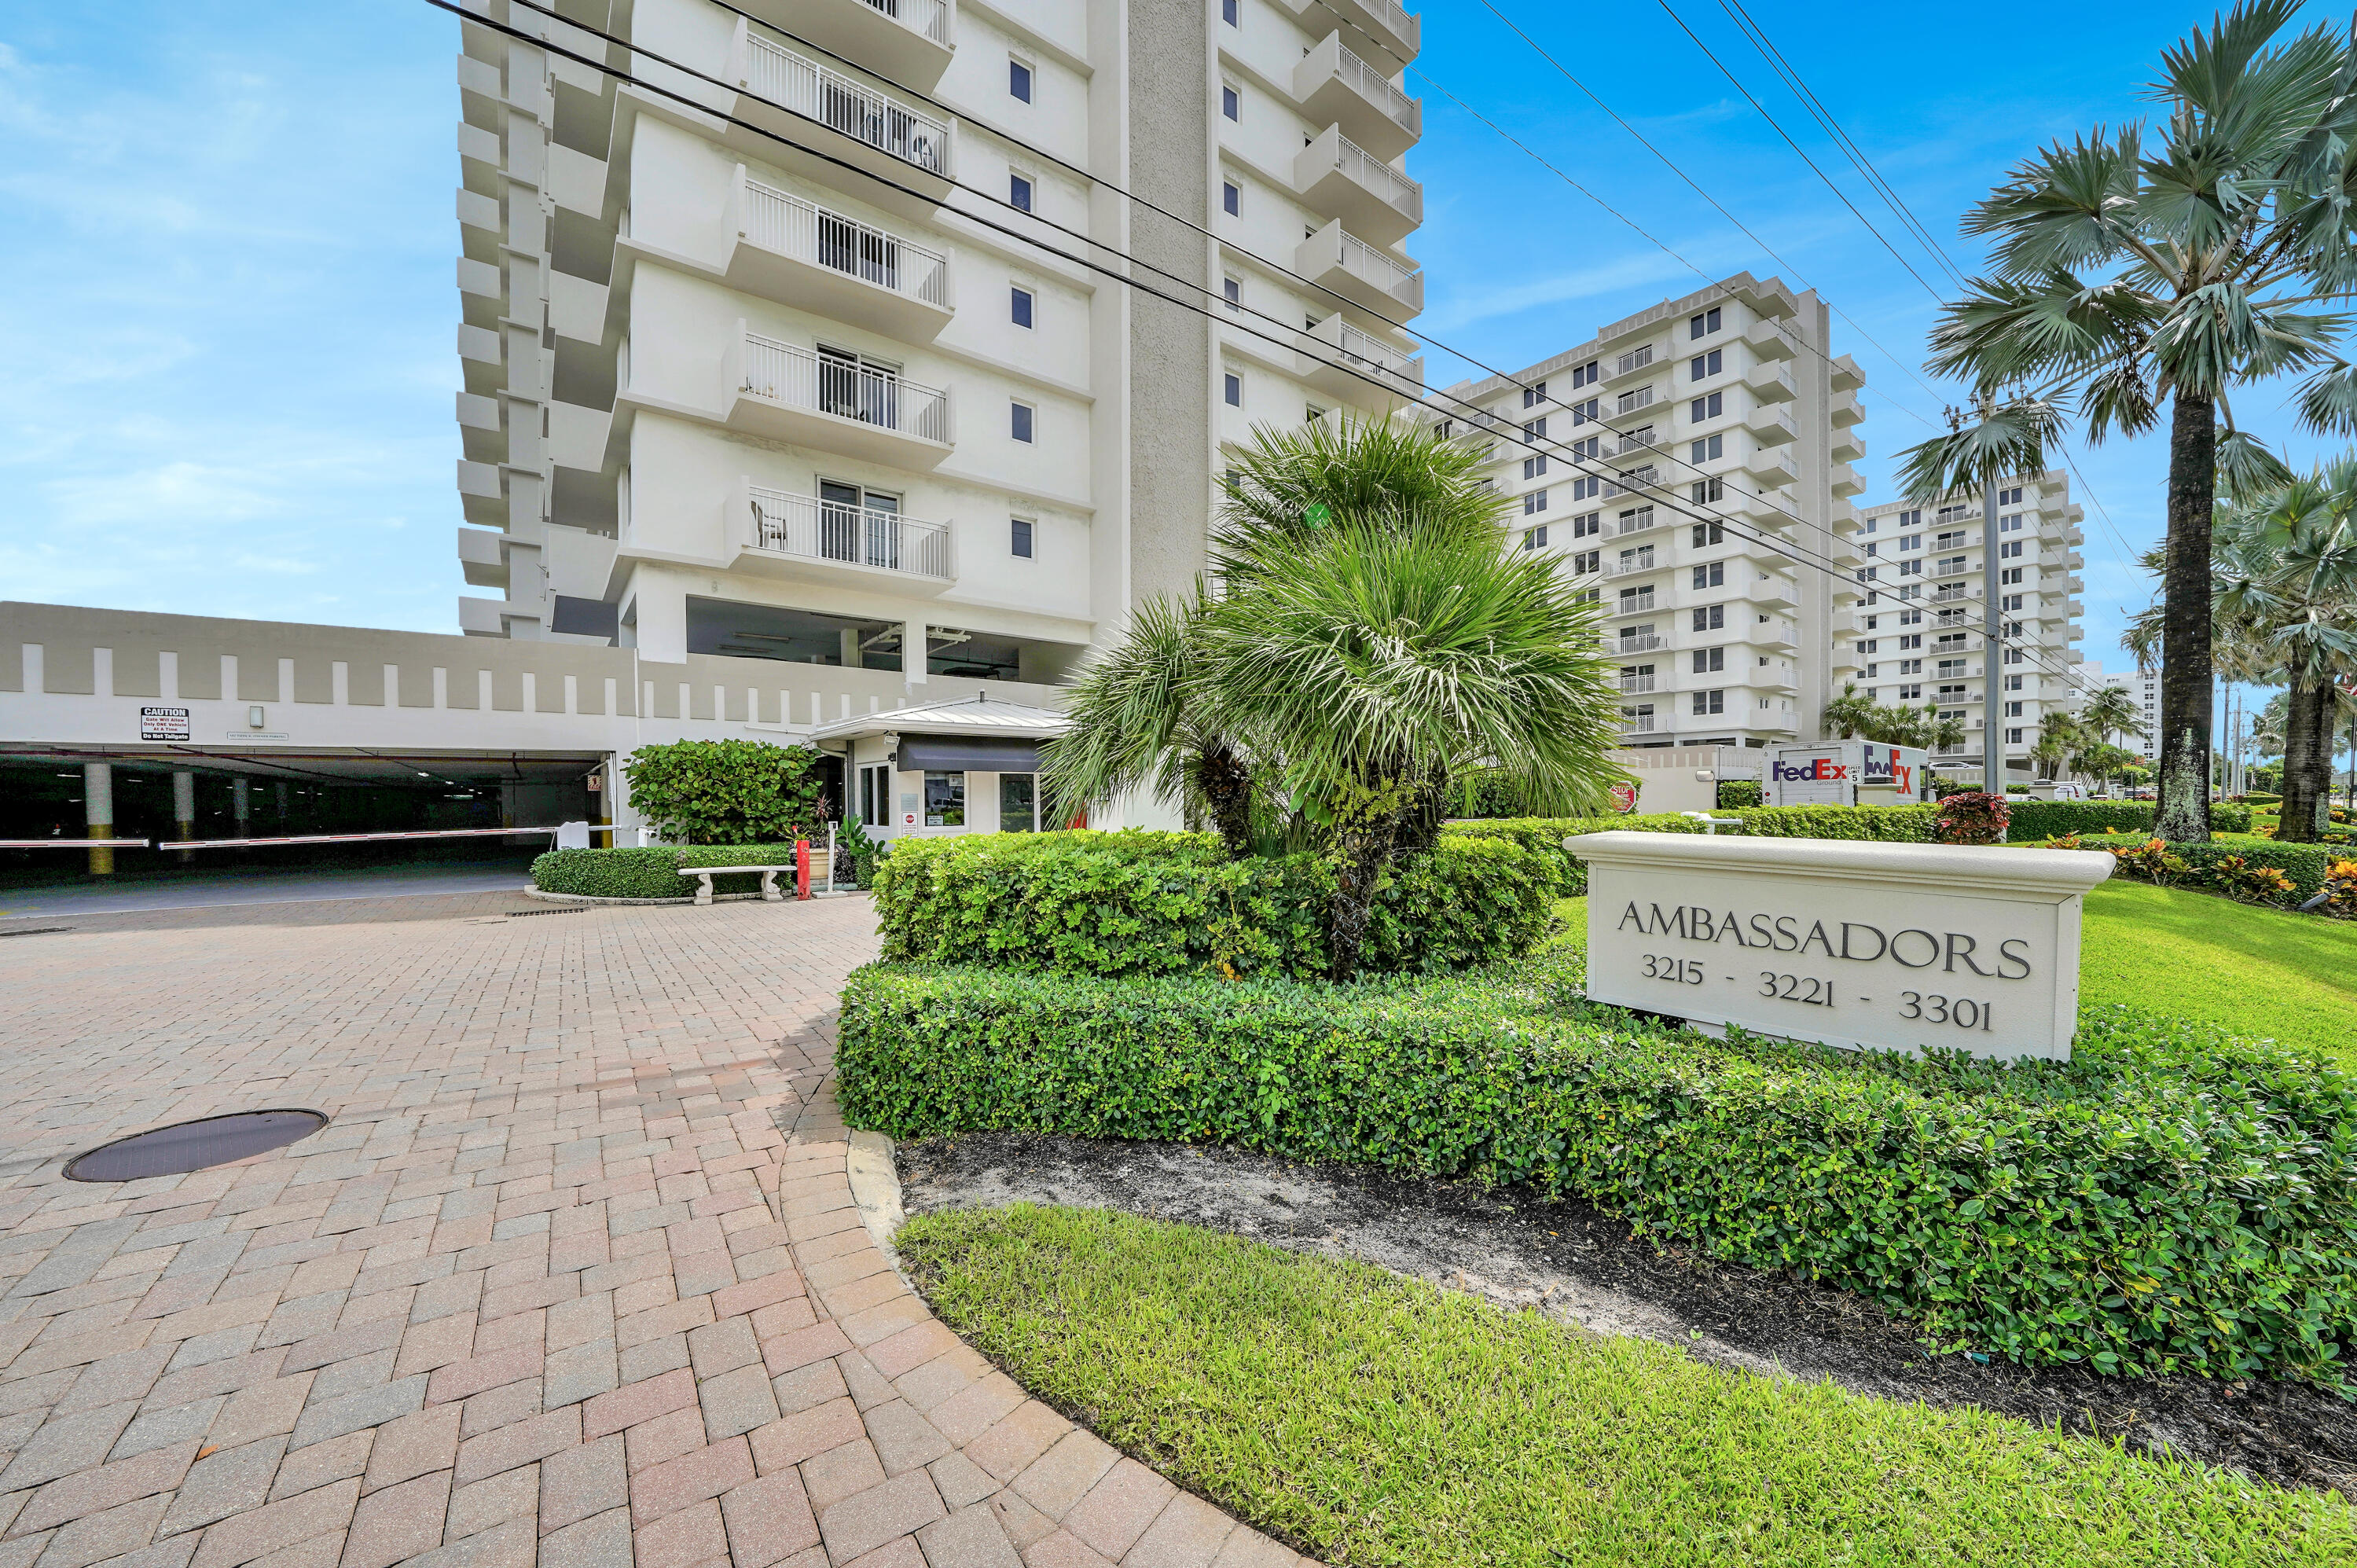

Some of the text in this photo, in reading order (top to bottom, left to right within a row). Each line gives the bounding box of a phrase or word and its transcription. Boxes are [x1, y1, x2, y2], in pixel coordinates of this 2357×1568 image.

[1772, 758, 1847, 781] FedEx
[1617, 901, 2031, 980] AMBASSADORS
[1641, 954, 1704, 986] 3215
[1758, 971, 1835, 1008] 3221
[1898, 991, 1993, 1031] 3301
